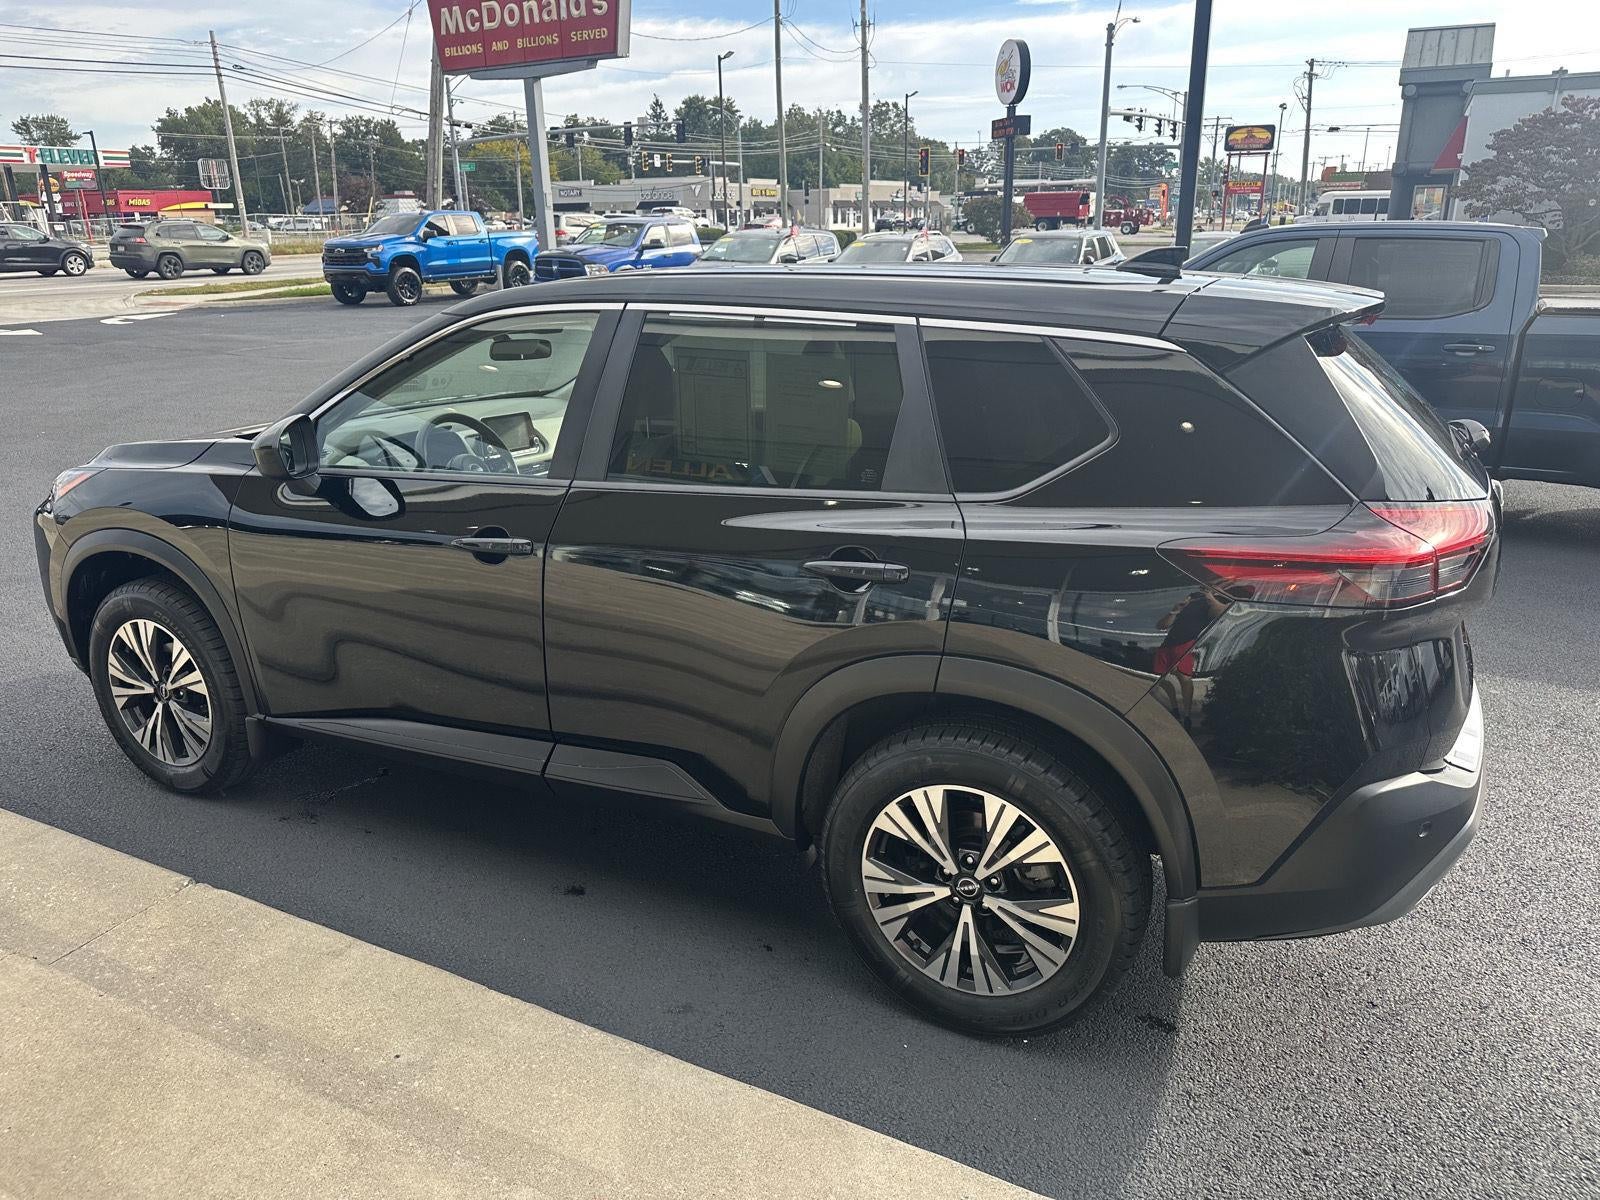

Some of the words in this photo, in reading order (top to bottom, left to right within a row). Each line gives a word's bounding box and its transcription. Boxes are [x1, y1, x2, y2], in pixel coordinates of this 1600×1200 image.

[440, 0, 609, 36] McDonalds
[444, 43, 483, 57] BILLIONS
[491, 40, 509, 52] AND
[516, 33, 560, 49] BILLIONS
[570, 28, 608, 42] SERVED
[559, 190, 581, 198] NOTARY
